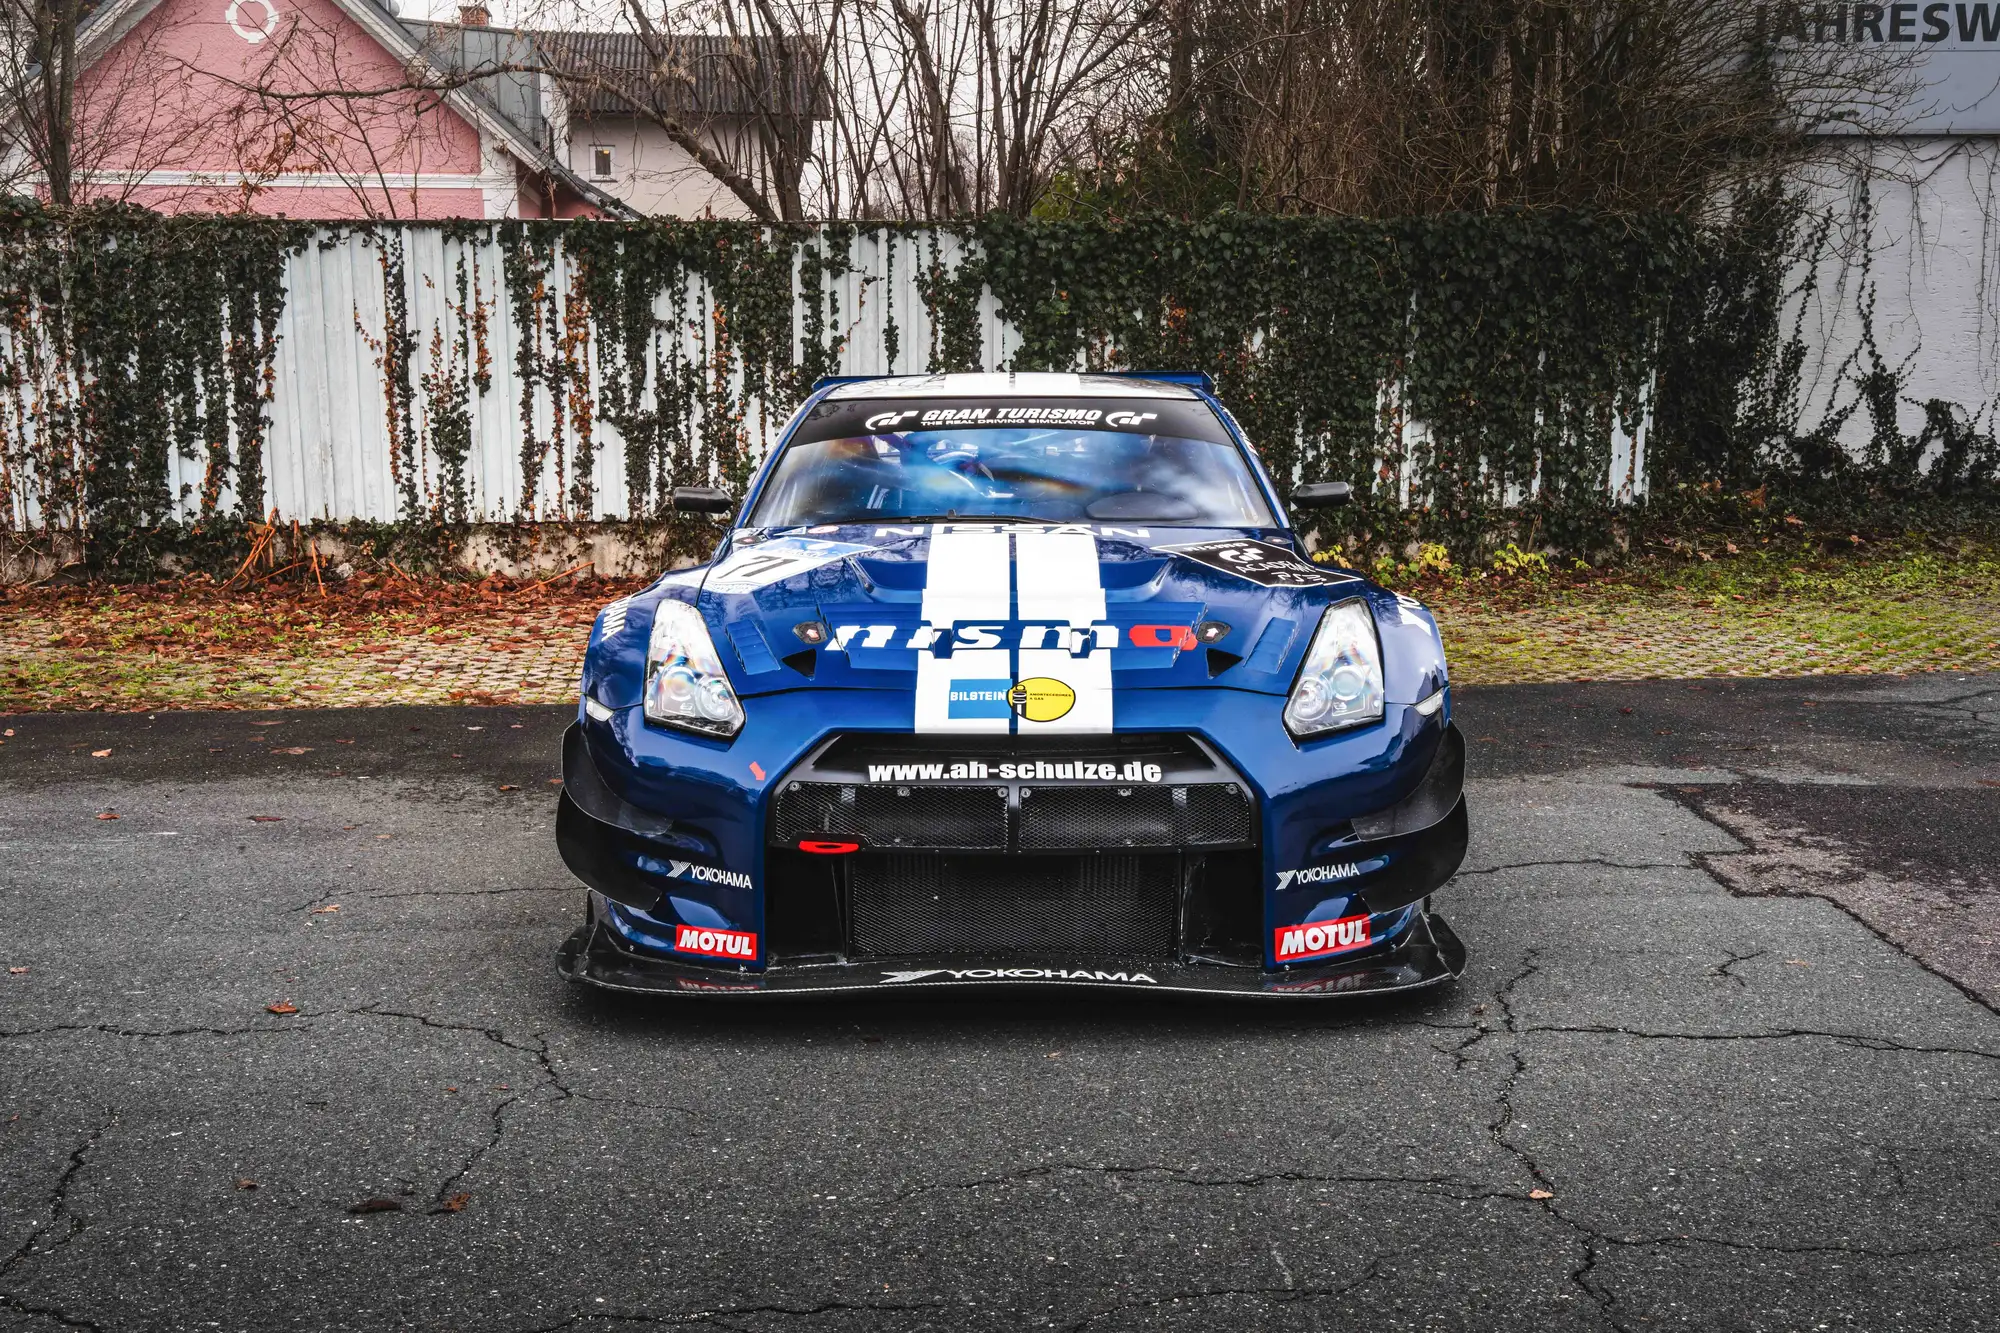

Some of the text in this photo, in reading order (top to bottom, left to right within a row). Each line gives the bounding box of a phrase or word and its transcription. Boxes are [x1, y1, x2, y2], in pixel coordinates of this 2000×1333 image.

[922, 408, 1102, 421] GRAN TURISMO
[875, 523, 1150, 538] NISSAN
[717, 555, 799, 579] 71
[1236, 560, 1317, 574] ACADEMY
[950, 691, 1007, 701] BILSTEIN
[868, 761, 1162, 783] www.ah-schulze.de
[690, 864, 753, 889] YOKOHAMA
[1295, 862, 1360, 885] YOKOHAMA
[678, 929, 752, 956] MOTUL
[1280, 919, 1366, 955] MOTUL
[947, 969, 1157, 984] YOKOHAMA
